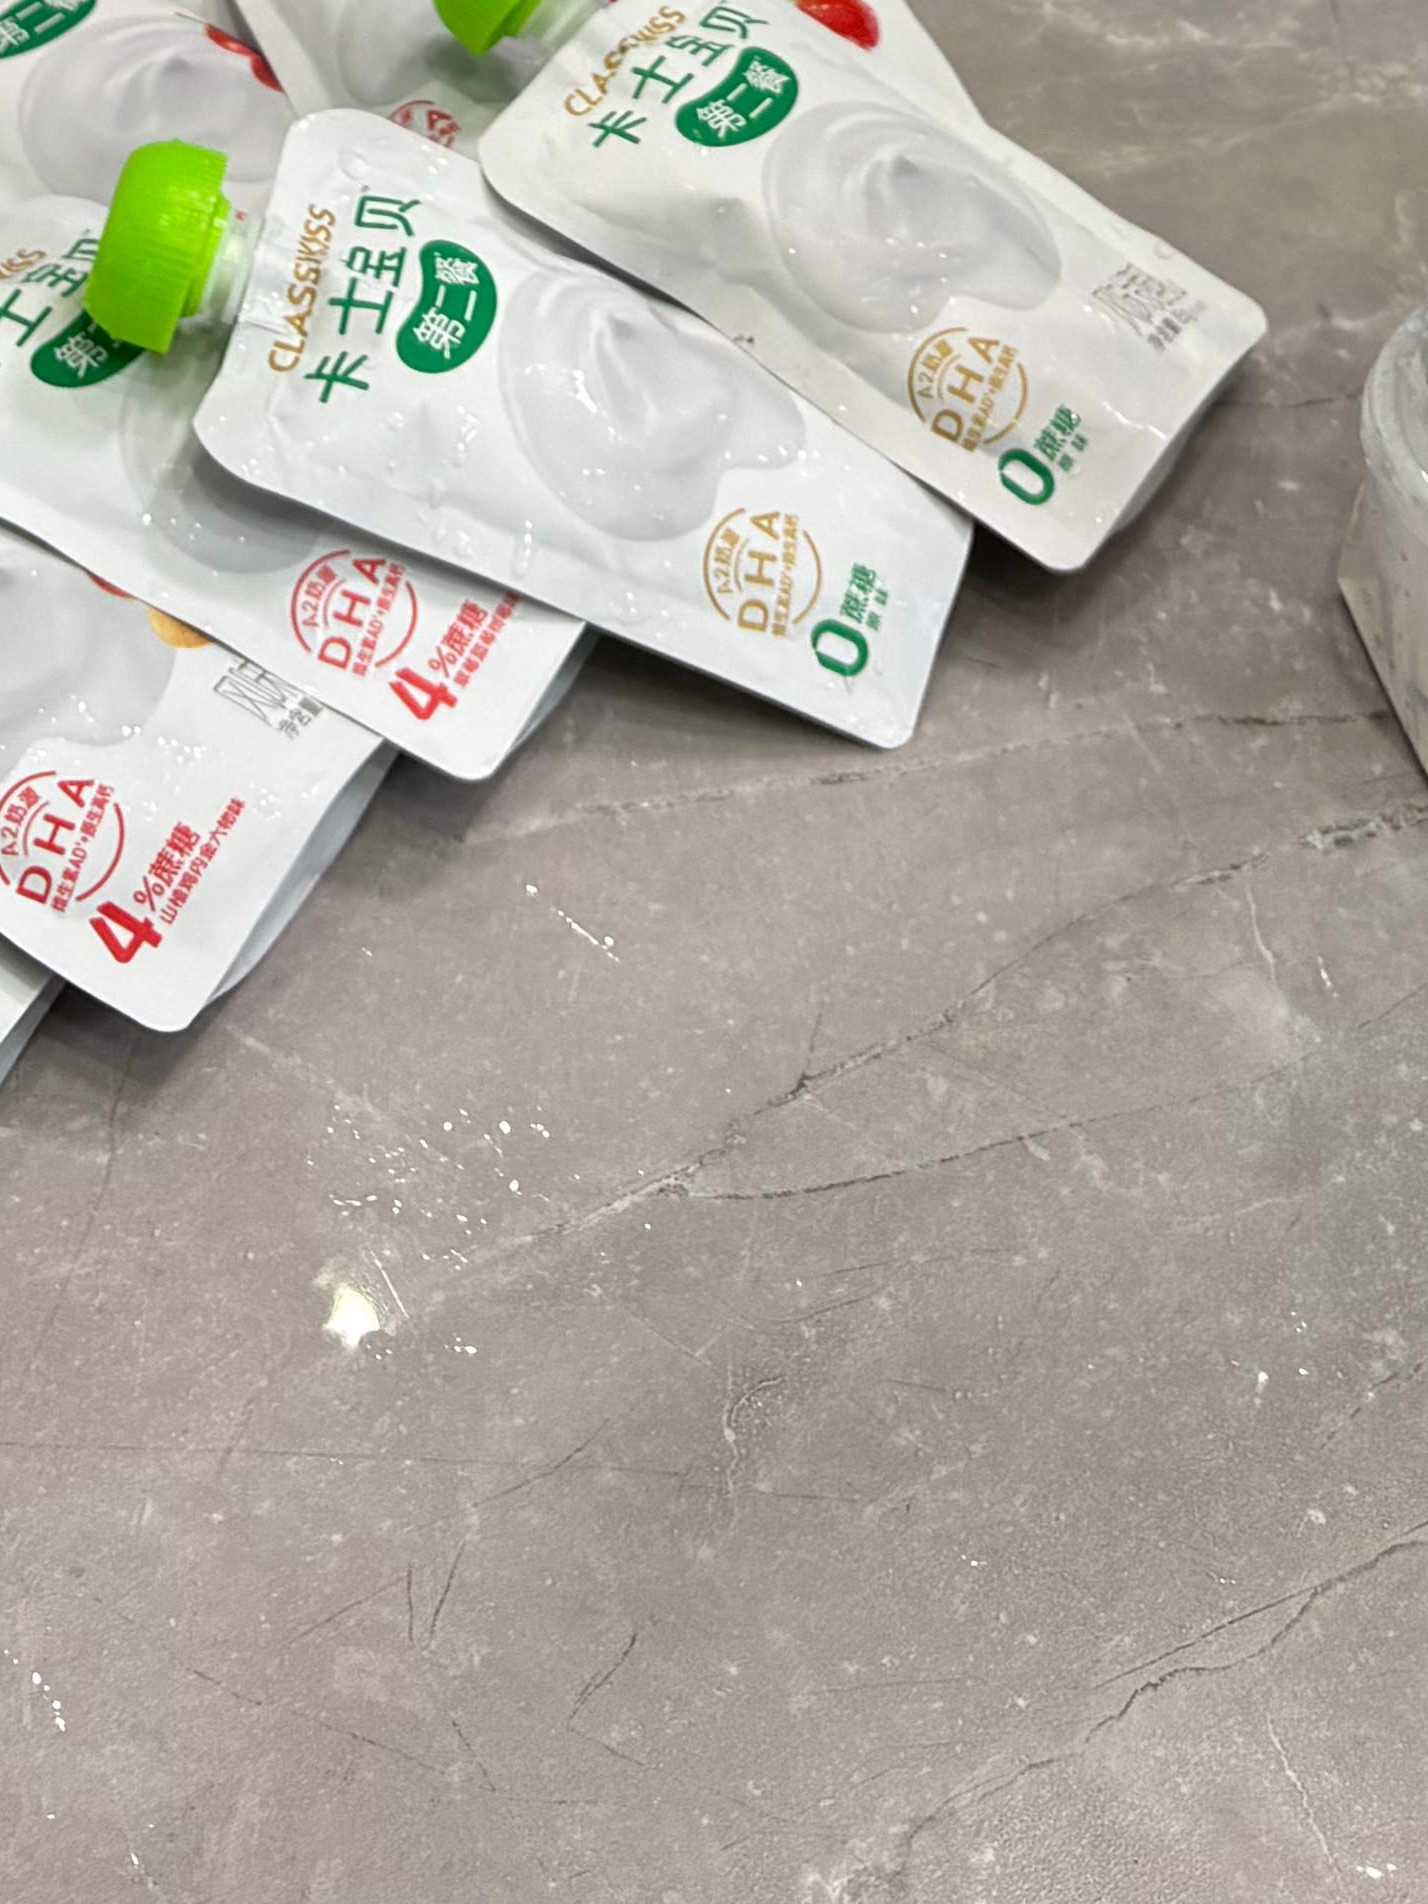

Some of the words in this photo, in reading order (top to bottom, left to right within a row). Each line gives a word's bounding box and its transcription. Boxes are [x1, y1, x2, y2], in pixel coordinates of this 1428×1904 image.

[588, 0, 769, 147] 卡士宝贝
[695, 55, 791, 142] 第二餐
[304, 195, 421, 404] 卡士宝贝
[413, 252, 480, 360] 第二餐
[930, 336, 1001, 444] DHA
[317, 557, 387, 671] DHA
[737, 510, 781, 633] DHA
[15, 778, 95, 906] DHA
